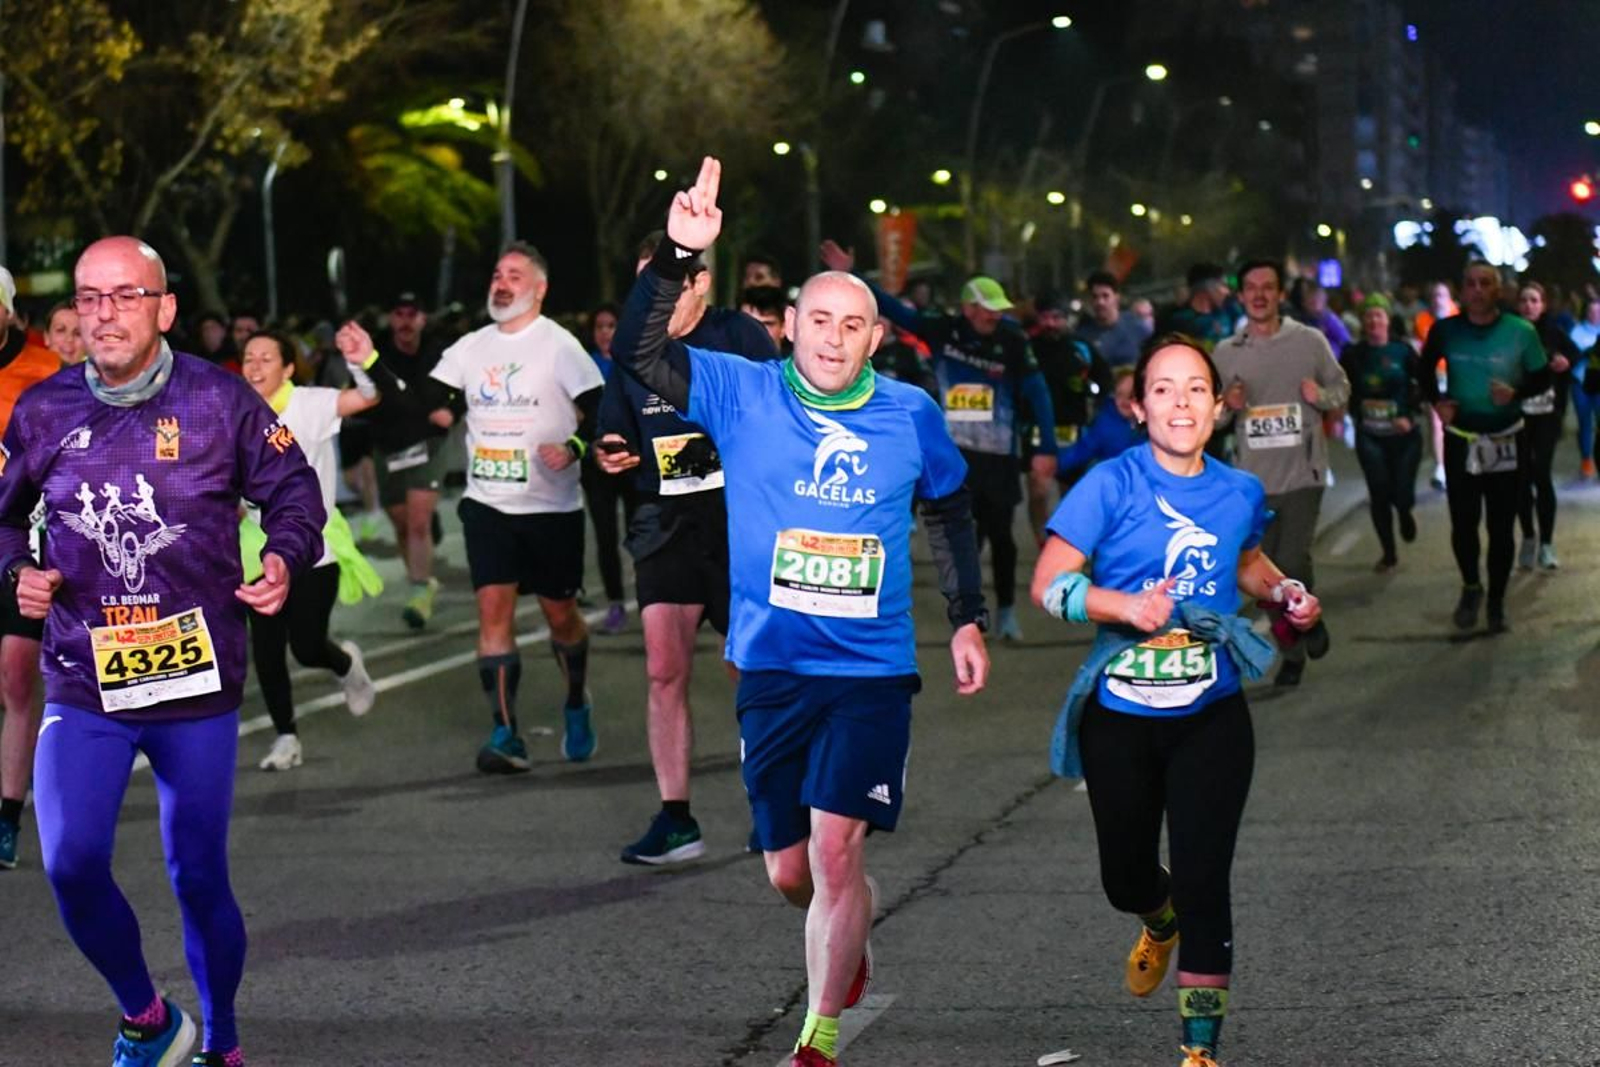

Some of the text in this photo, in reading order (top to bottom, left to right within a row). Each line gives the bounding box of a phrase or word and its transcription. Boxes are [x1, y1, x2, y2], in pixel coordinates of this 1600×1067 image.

[1251, 415, 1297, 434] 5638
[474, 458, 524, 478] 2935
[794, 480, 876, 504] GACELAS
[801, 535, 820, 550] 42
[780, 551, 870, 588] 2081
[101, 593, 160, 606] C.D. BEDMAR
[115, 629, 137, 644] 42
[104, 636, 203, 678] 4325
[1113, 646, 1206, 678] 2145
